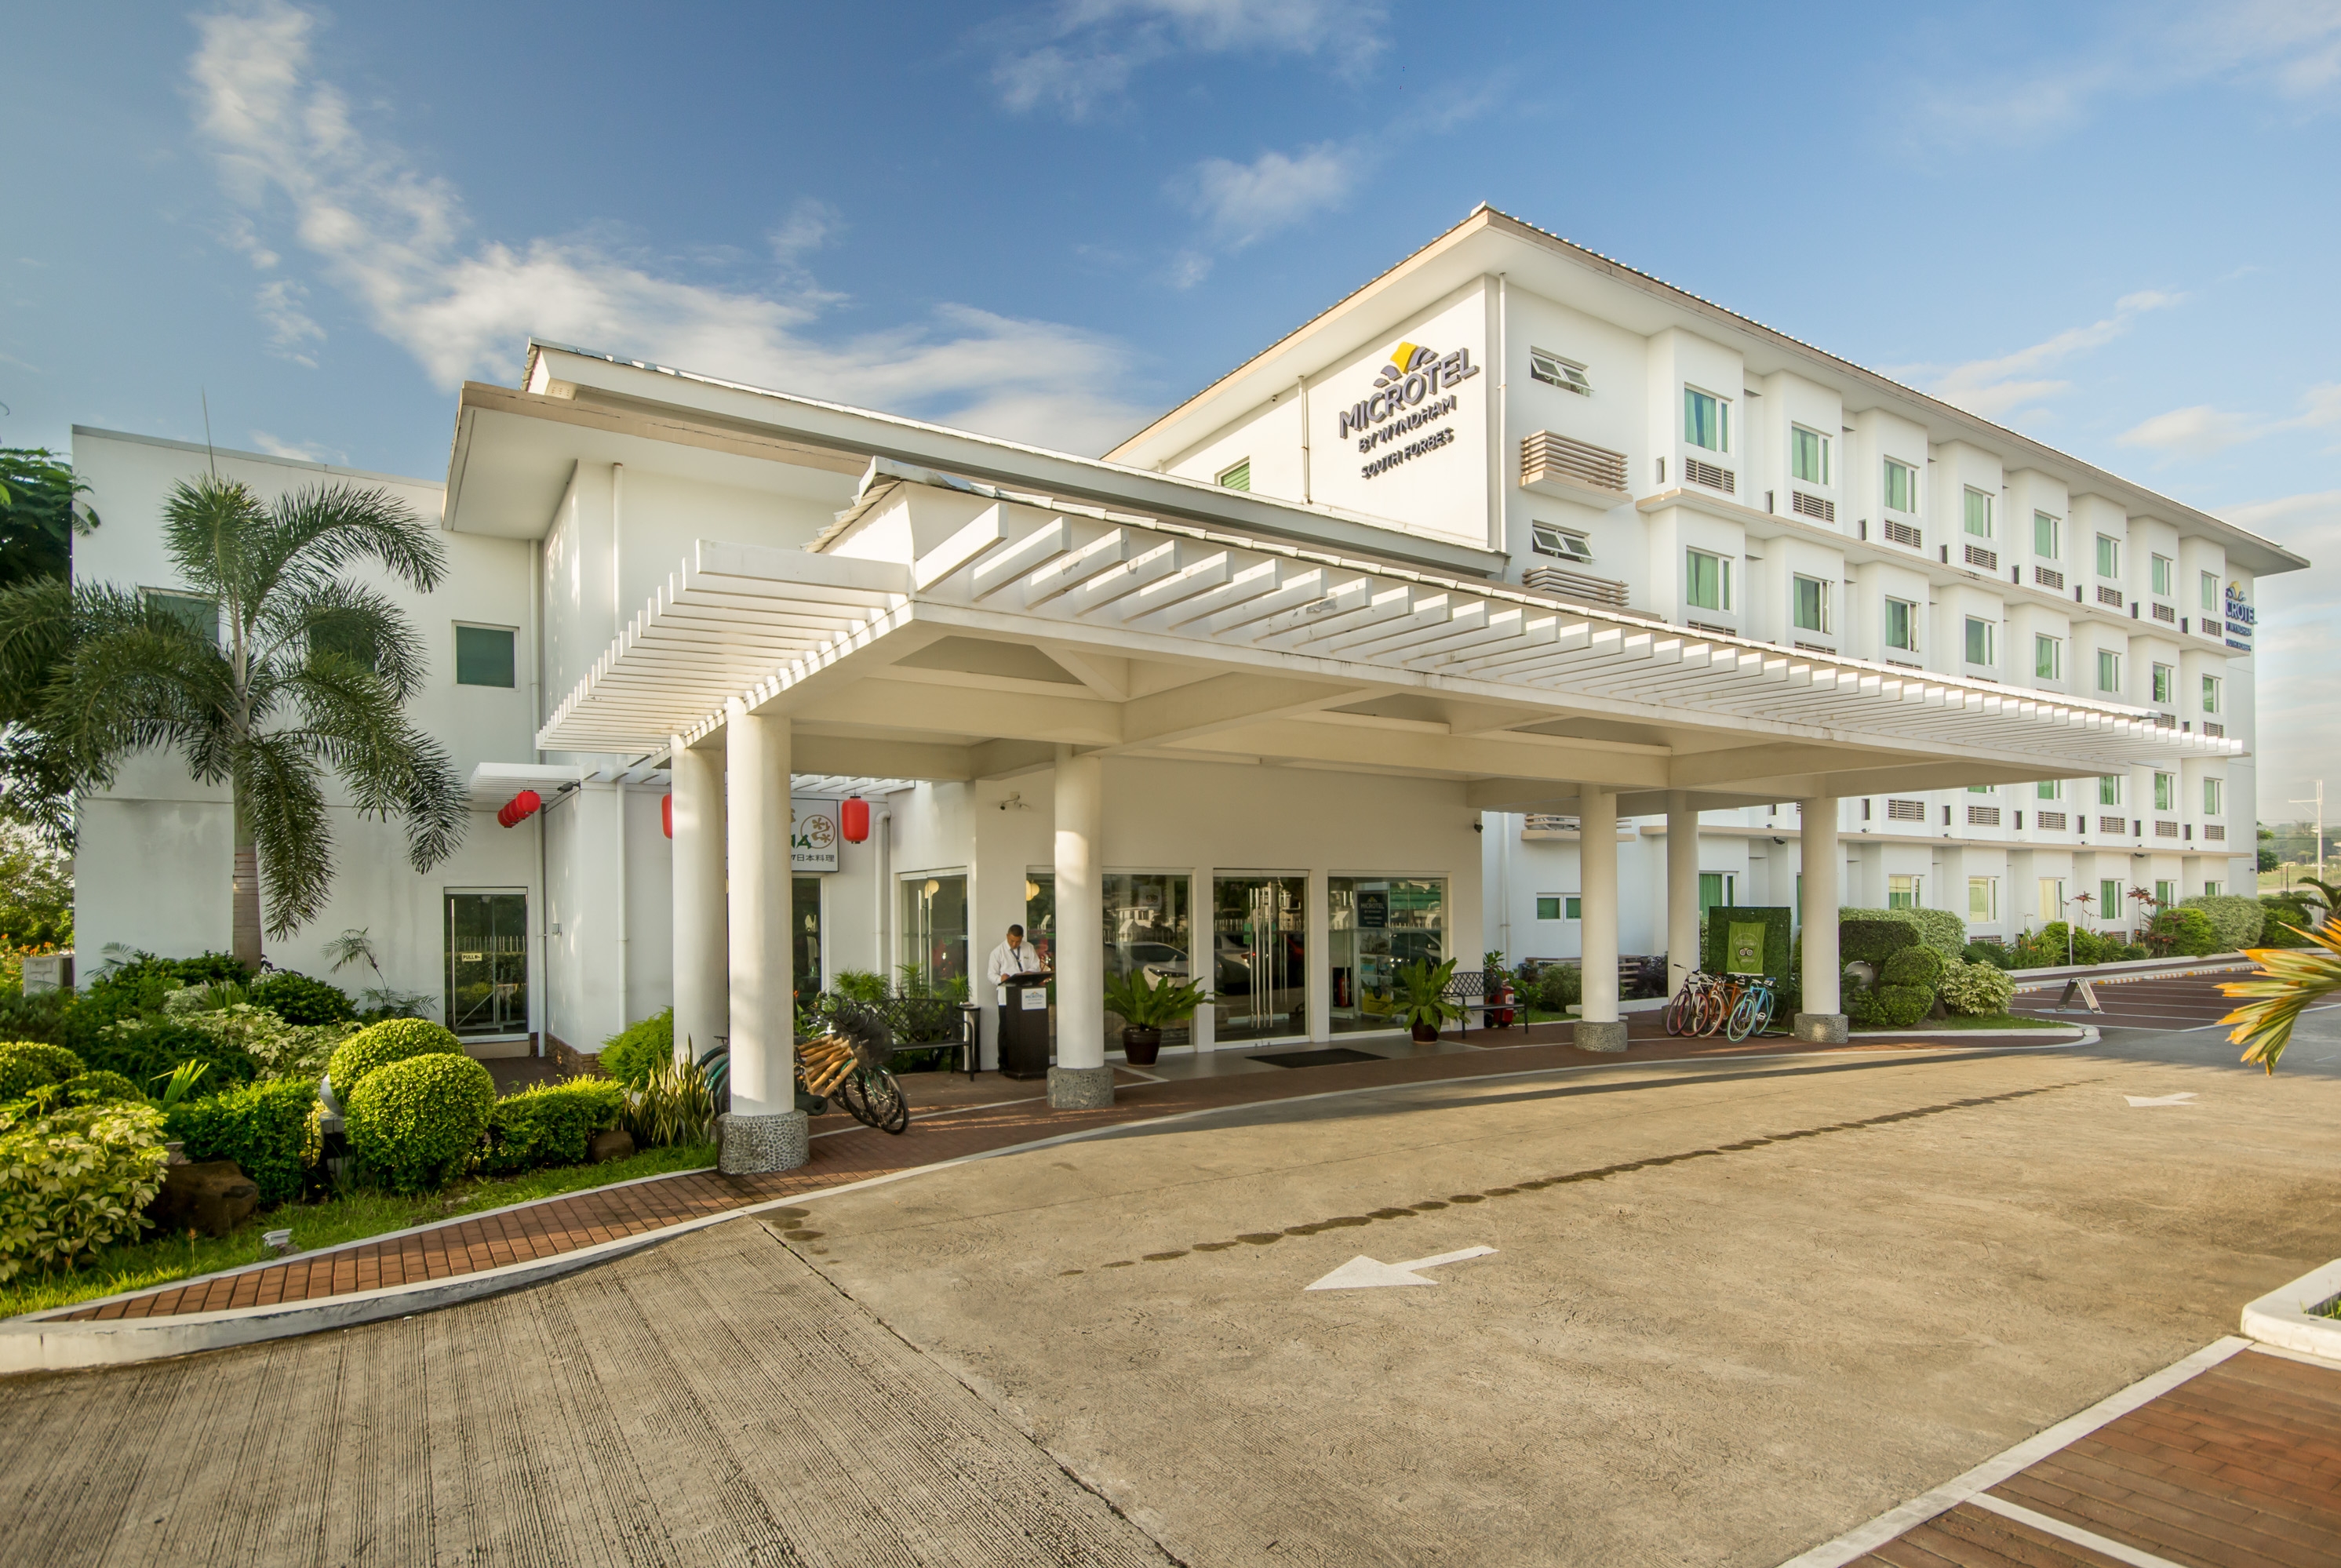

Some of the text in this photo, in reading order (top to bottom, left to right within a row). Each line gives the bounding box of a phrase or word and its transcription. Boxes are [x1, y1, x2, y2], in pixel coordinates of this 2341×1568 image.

[1339, 347, 1480, 439] MICROTEL
[1359, 395, 1457, 453] BY WYNDHAM
[1361, 427, 1454, 479] SOUTH FORBES
